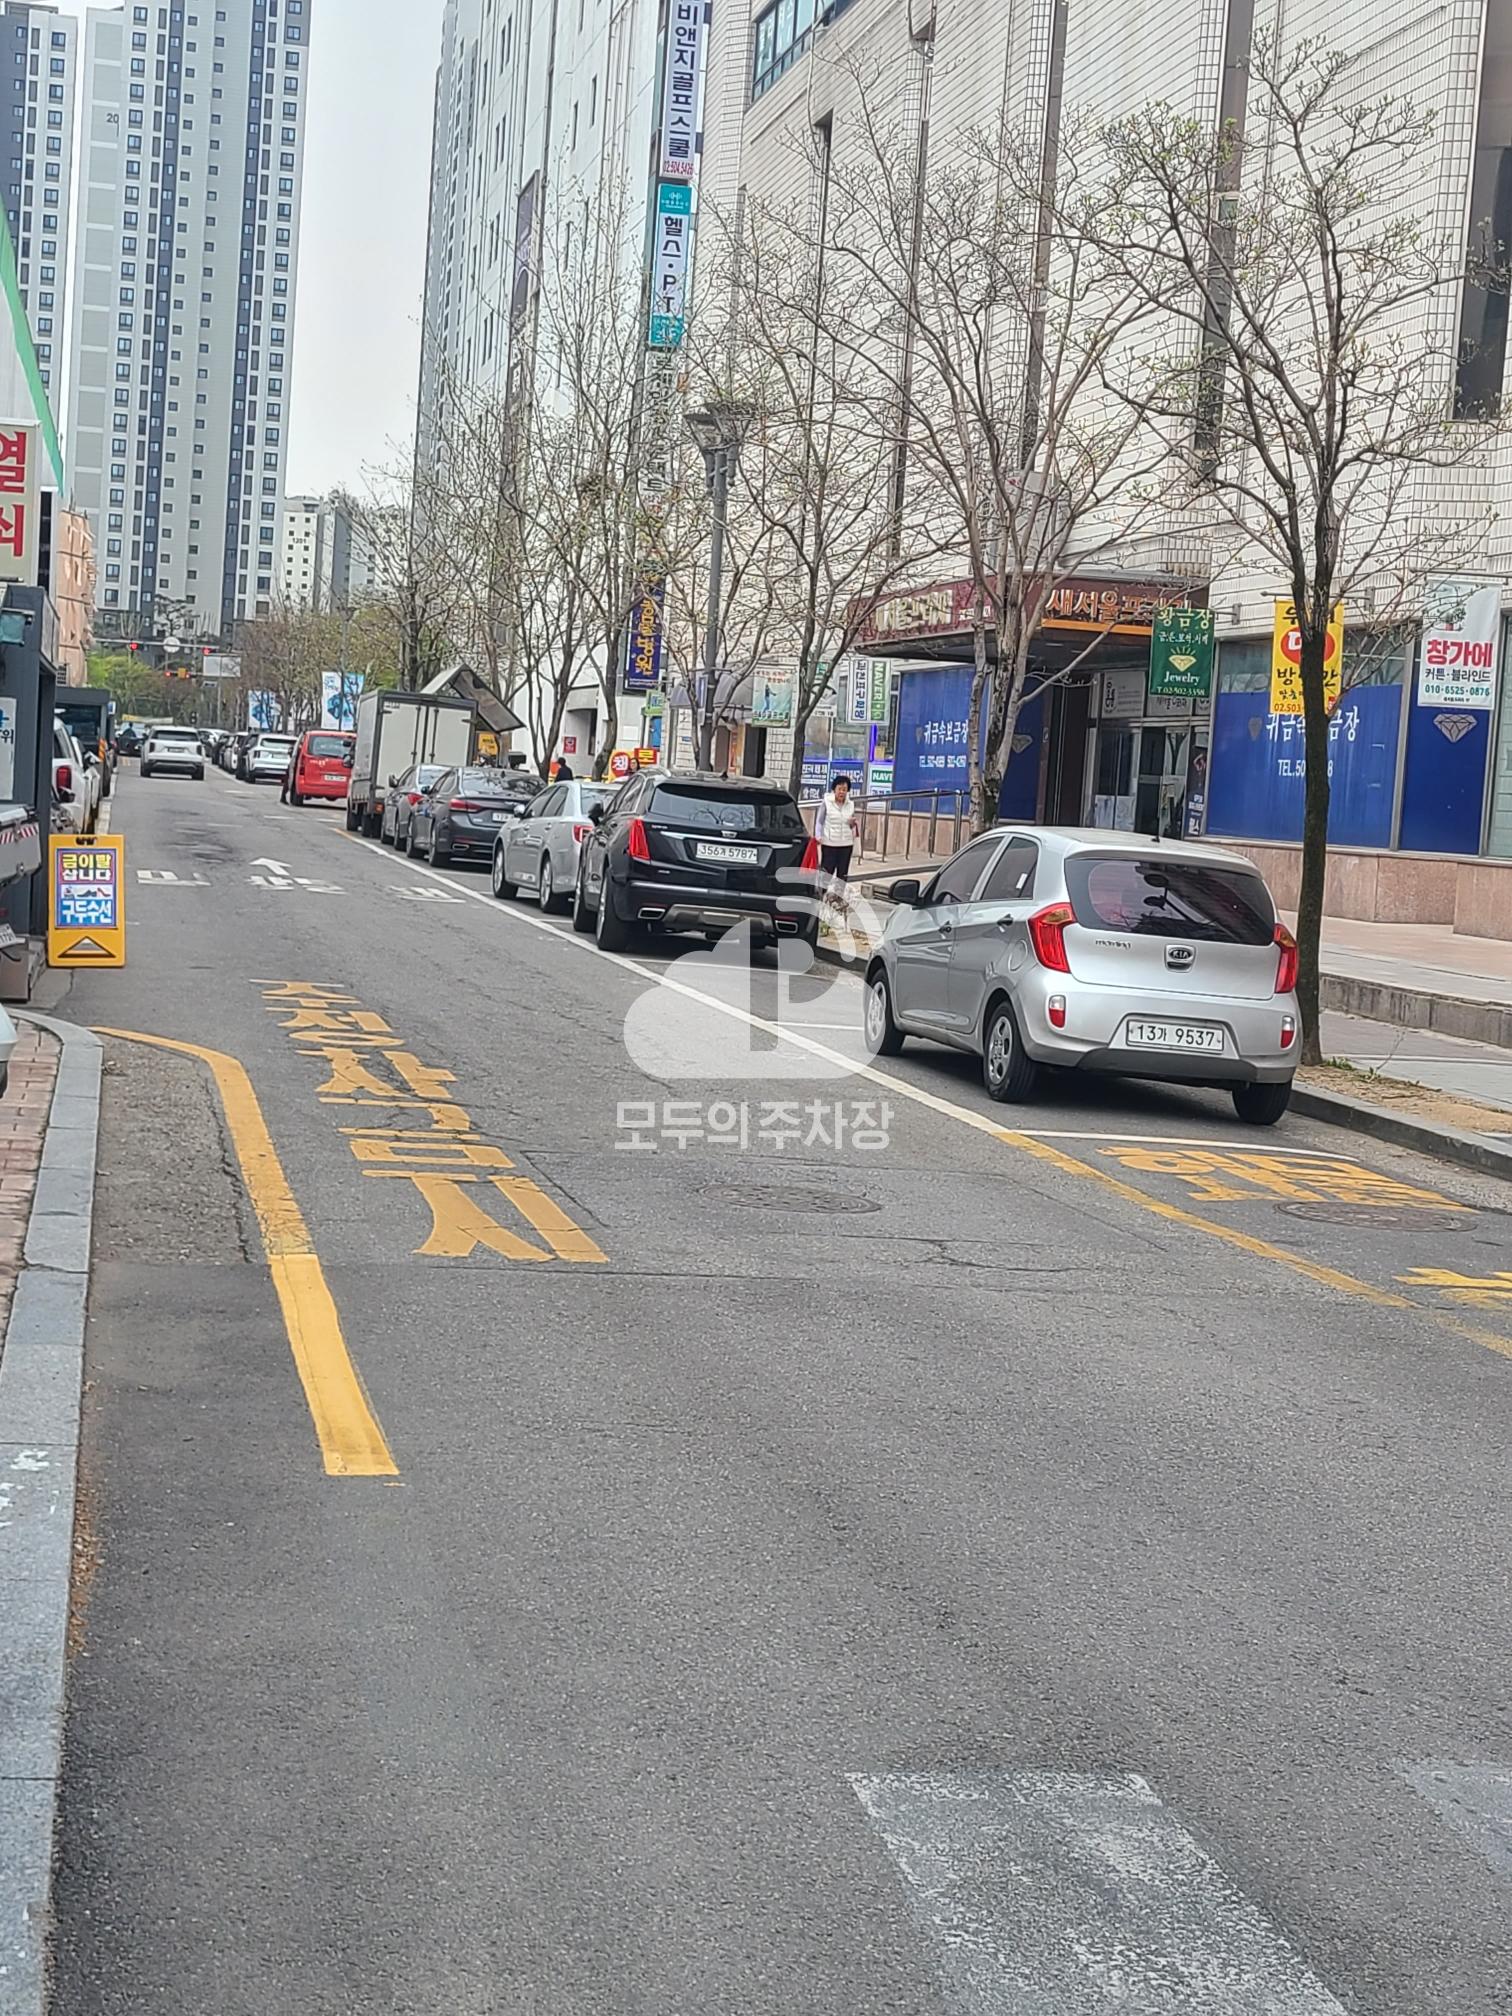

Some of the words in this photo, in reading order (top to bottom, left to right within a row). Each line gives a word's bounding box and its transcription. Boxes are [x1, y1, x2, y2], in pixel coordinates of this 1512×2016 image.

[1426, 639, 1494, 668] 창가에
[1164, 671, 1201, 686] Jewelry
[728, 848, 754, 859] 5787
[62, 868, 112, 881] 삽니다
[61, 900, 113, 924] 구두수선
[1172, 949, 1192, 960] KIA
[1137, 1024, 1168, 1043] 13가
[1175, 1028, 1216, 1048] 9537
